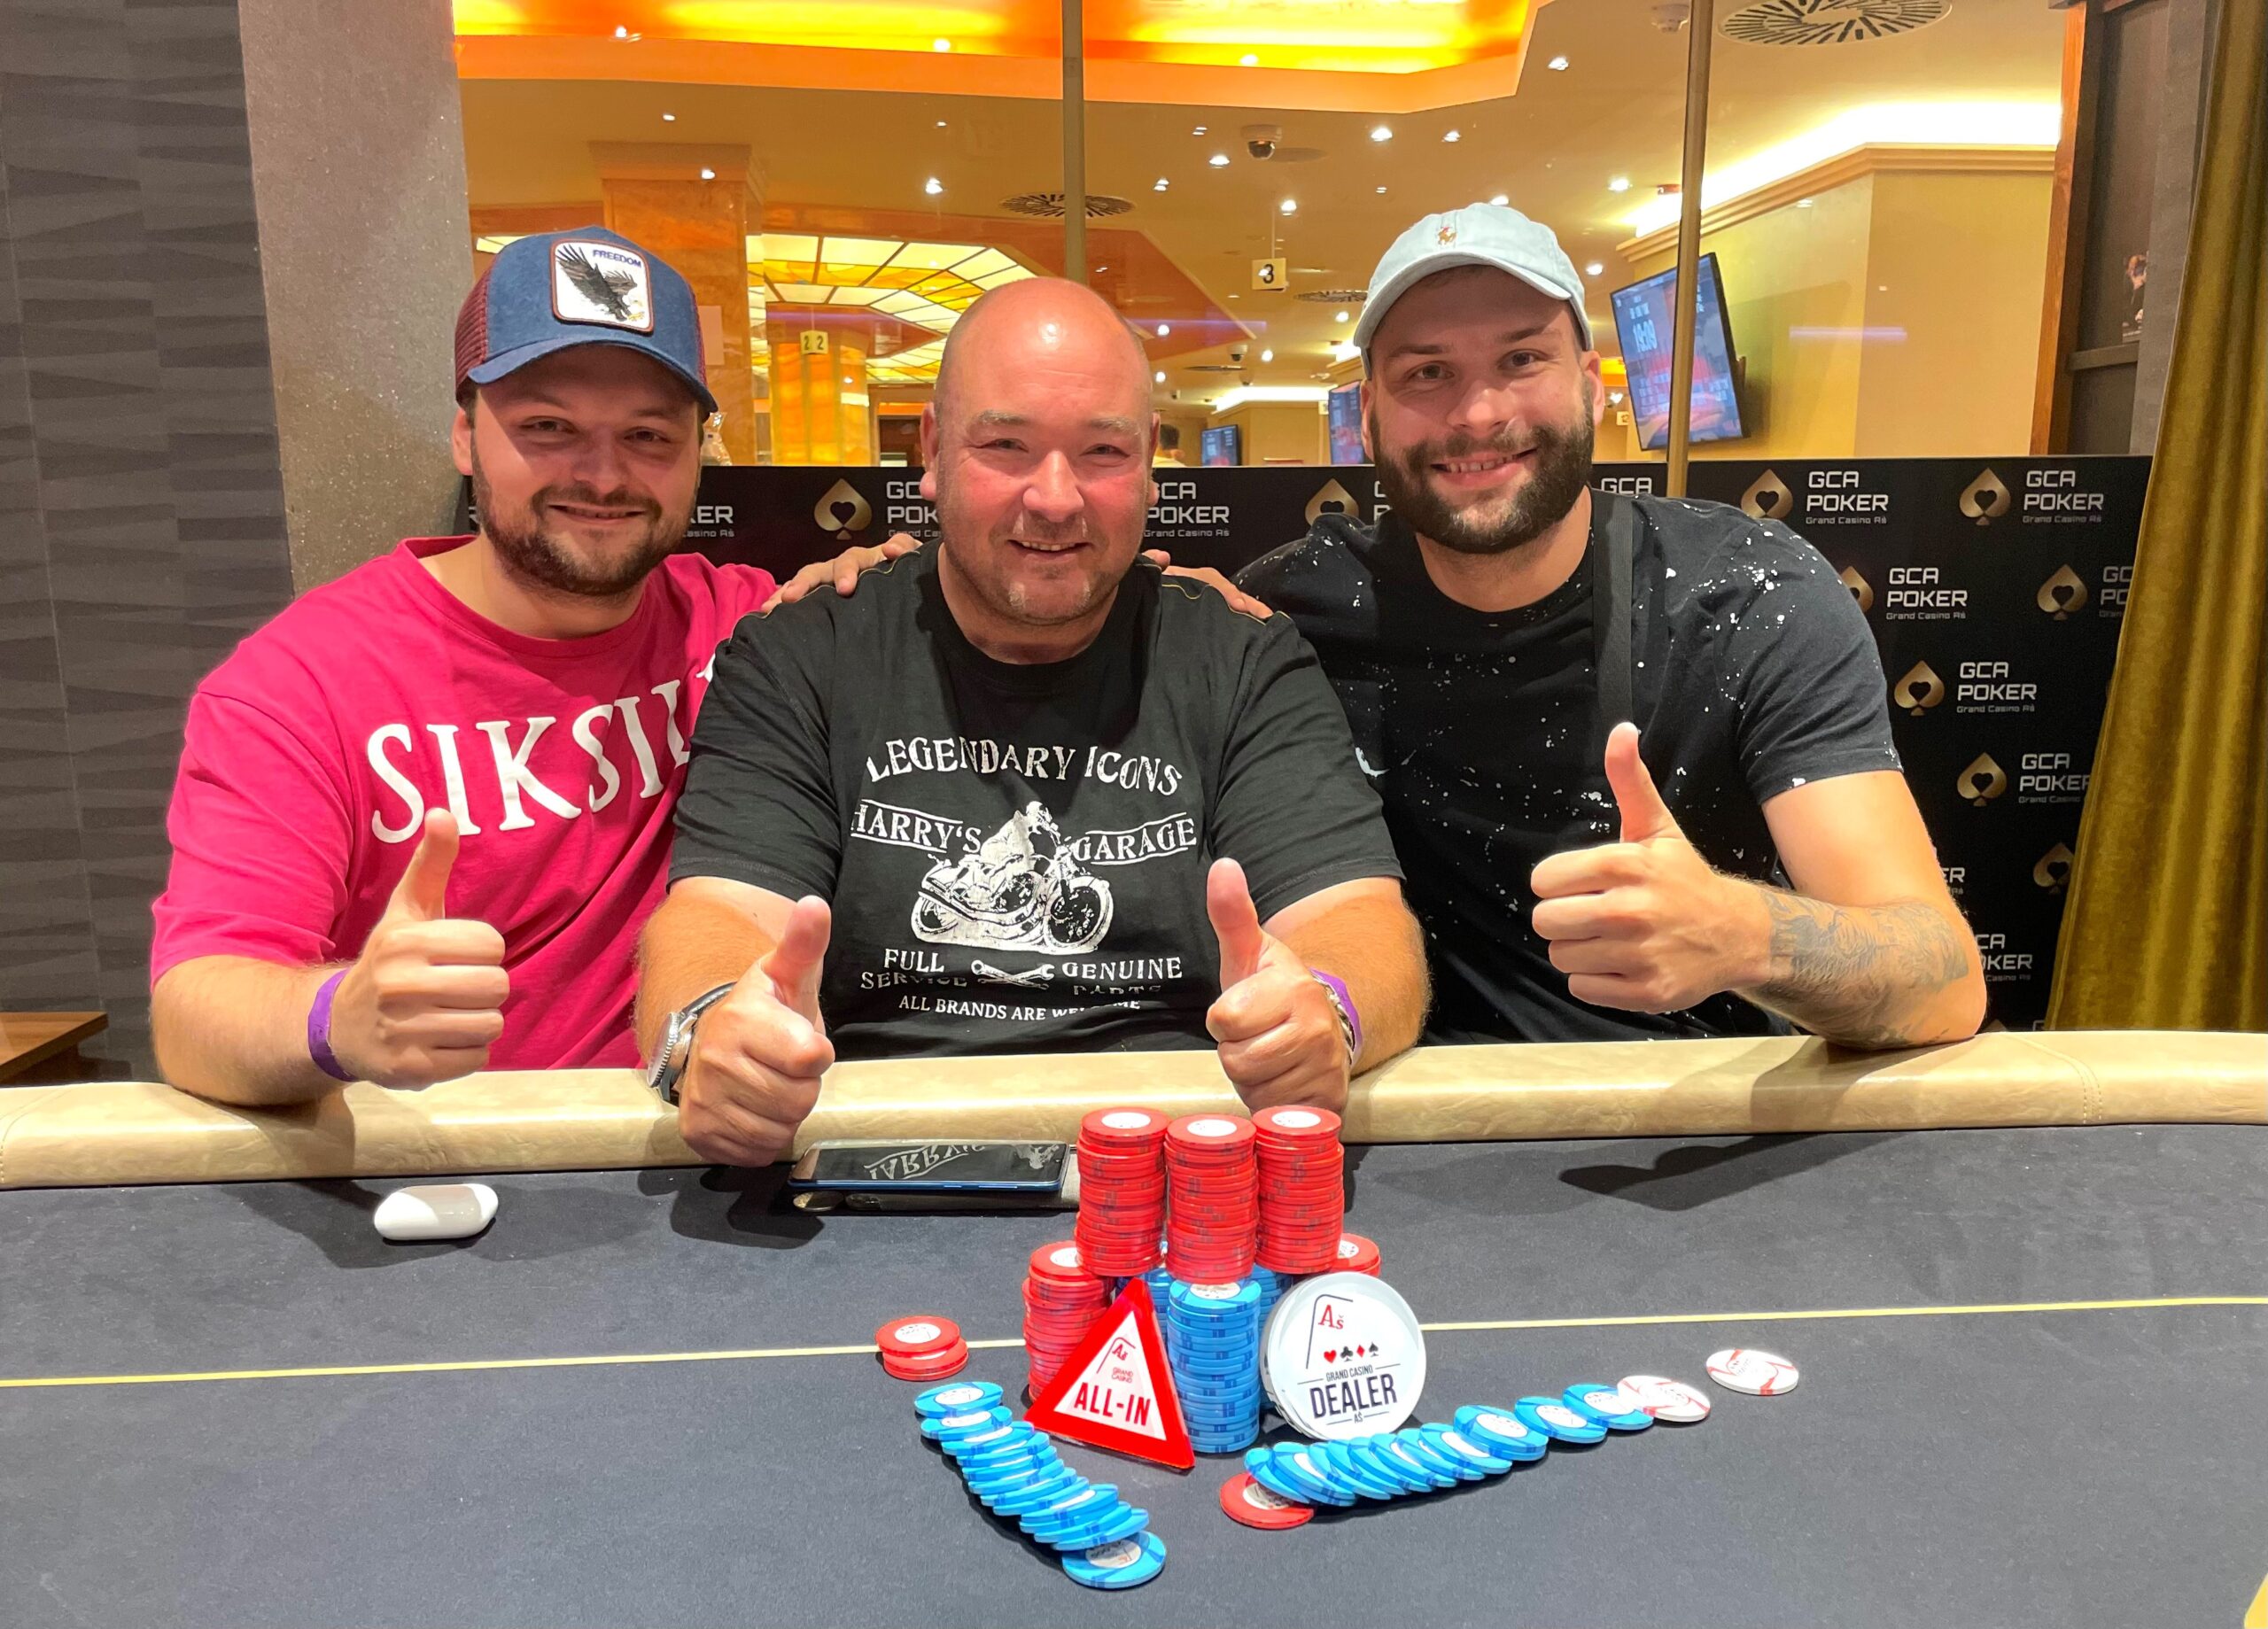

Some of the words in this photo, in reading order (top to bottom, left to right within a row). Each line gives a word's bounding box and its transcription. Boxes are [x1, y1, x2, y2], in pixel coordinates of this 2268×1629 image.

[593, 249, 641, 268] FREEDOM
[1262, 263, 1274, 284] 3
[816, 335, 824, 351] 2
[1601, 477, 1652, 494] GCA
[1808, 470, 1860, 488] GCA
[2026, 470, 2076, 487] GCA
[886, 481, 923, 500] GC
[1156, 482, 1197, 500] CA
[1806, 494, 1889, 512] POKER
[2023, 493, 2104, 510] POKER
[887, 506, 940, 524] POK
[1147, 506, 1230, 524] POKER
[1889, 567, 1939, 585] GCA
[2103, 566, 2133, 582] GC
[1886, 590, 1968, 607] POKER
[1960, 662, 2009, 679] GCA
[1957, 684, 2038, 701] POKER
[367, 654, 715, 844] SIKSIL
[865, 736, 1076, 783] LEGENDARY
[1084, 746, 1183, 795] ICONS
[2021, 753, 2070, 770] GCA
[1073, 818, 1197, 862] GARAGE
[1975, 934, 2006, 950] CA
[884, 948, 944, 973] FULL
[1062, 957, 1183, 981] GENUINE
[1981, 955, 2033, 970] KER
[899, 995, 930, 1011] ALL
[935, 998, 1007, 1020] BRANDS
[1011, 1004, 1045, 1020] ARE
[1113, 1367, 1133, 1377] GRAND
[1325, 1369, 1349, 1382] GRAND
[1349, 1365, 1373, 1377] CASINO
[1074, 1382, 1151, 1426] ALL-IN
[1309, 1374, 1397, 1419] DEALER
